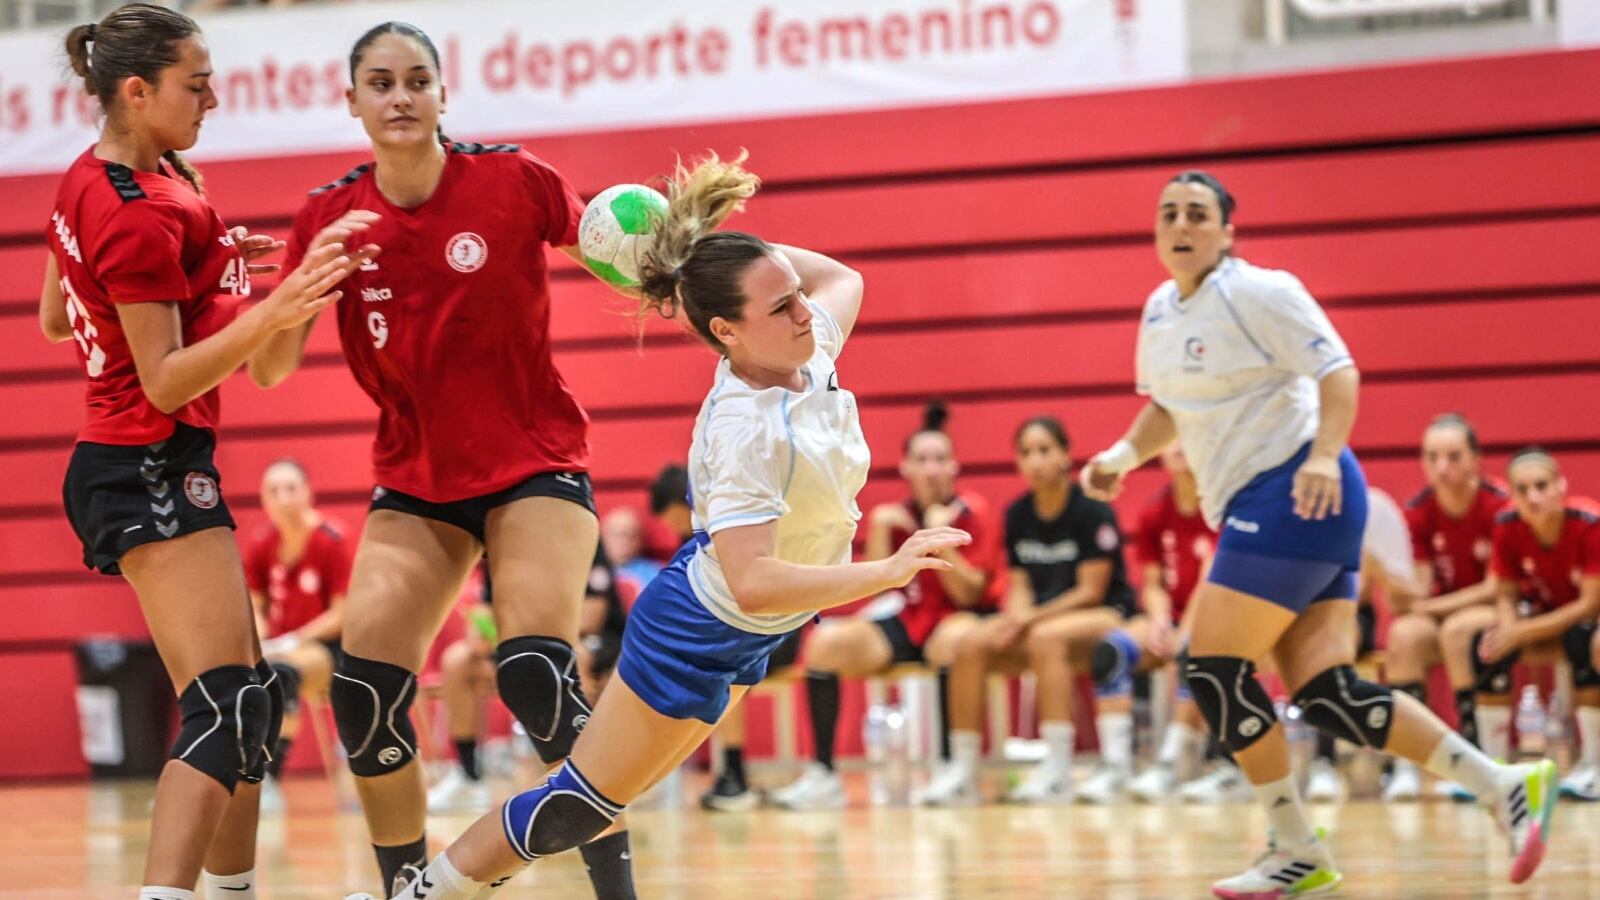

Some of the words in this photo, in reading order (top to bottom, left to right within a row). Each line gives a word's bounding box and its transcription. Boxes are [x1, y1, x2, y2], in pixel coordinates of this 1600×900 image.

[482, 25, 730, 99] deporte
[754, 1, 1061, 69] femenino
[368, 311, 389, 349] 9
